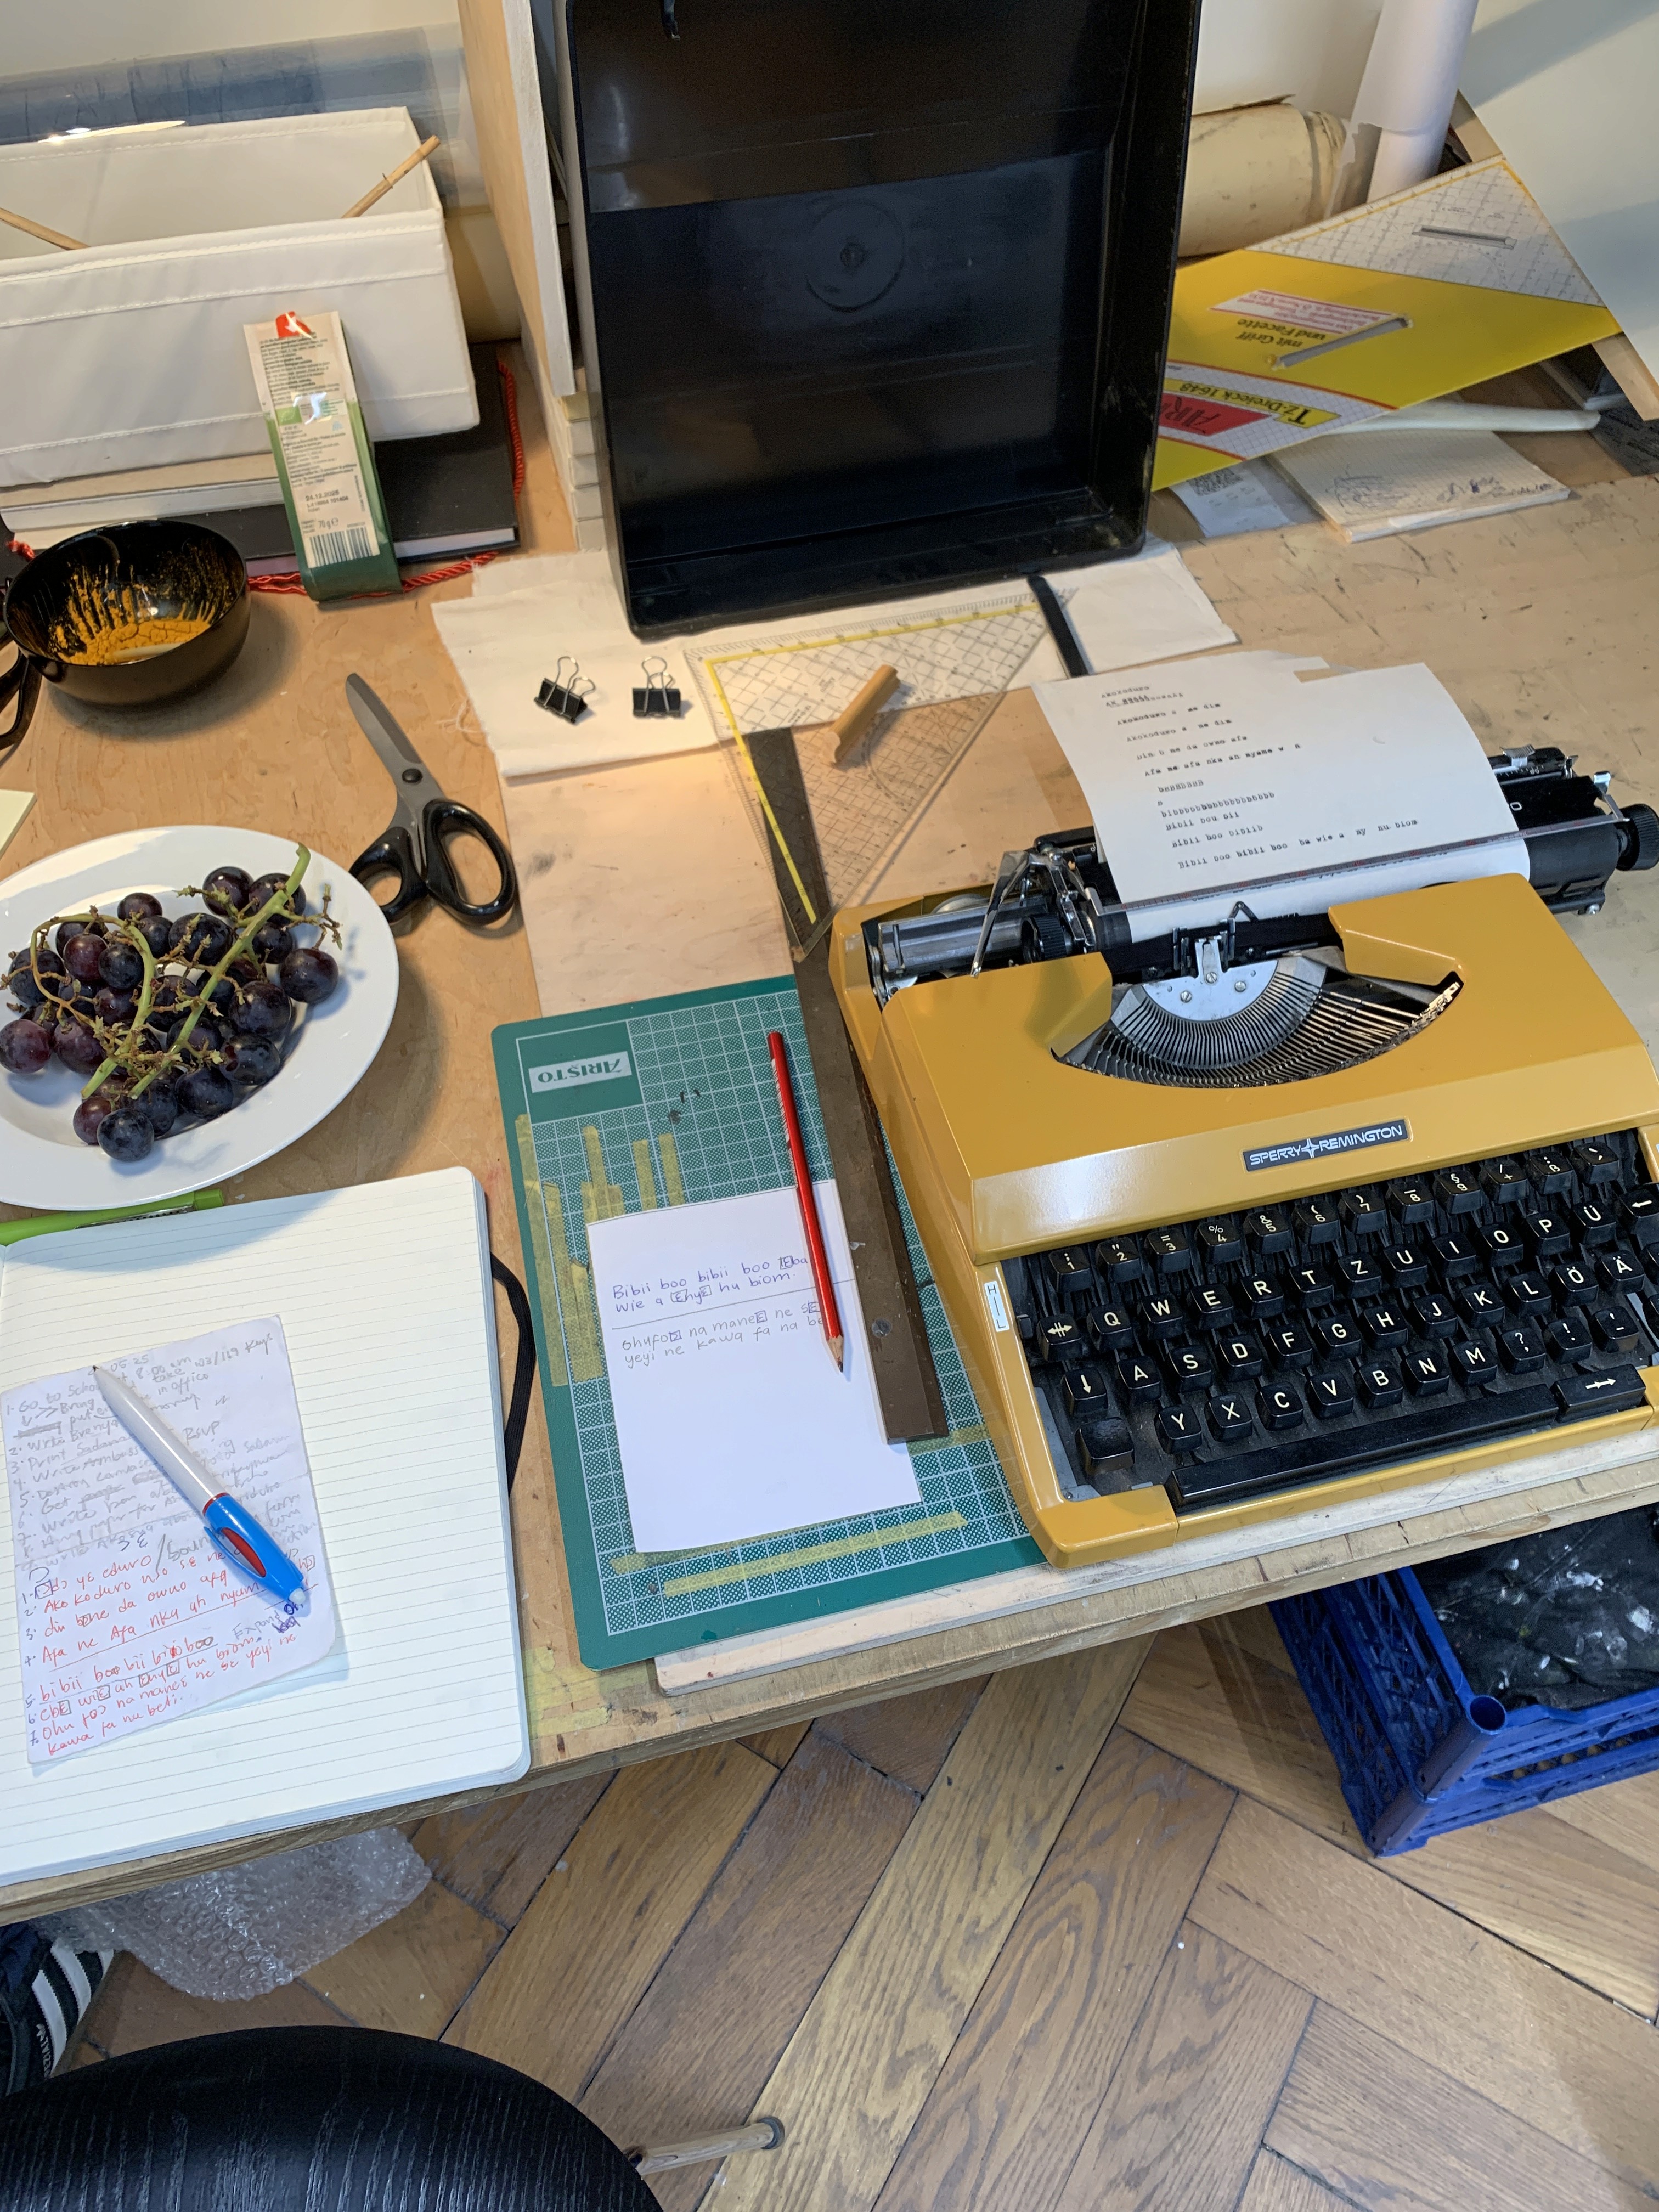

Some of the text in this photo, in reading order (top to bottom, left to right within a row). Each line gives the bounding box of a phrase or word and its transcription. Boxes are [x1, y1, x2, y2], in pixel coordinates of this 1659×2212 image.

[1235, 330, 1302, 348] mit Griff
[1237, 319, 1325, 341] und Facette
[1180, 382, 1219, 397] 1648
[318, 520, 325, 528] 70
[1178, 857, 1207, 869] Bibii
[1236, 847, 1265, 857] bibii
[1270, 843, 1288, 851] boo
[1316, 834, 1333, 843] wie
[1395, 819, 1418, 829] biom
[1205, 833, 1223, 841] boo
[538, 1058, 623, 1083] ARISTO
[1250, 1125, 1403, 1165] SPERRY REMINGTON
[1067, 1262, 1075, 1270] 1
[1116, 1252, 1128, 1261] 2
[1166, 1243, 1176, 1251] 3
[1217, 1234, 1227, 1242] 4
[1265, 1223, 1277, 1232] 5
[1314, 1214, 1326, 1222] 6
[1359, 1203, 1370, 1211] 7
[1409, 1193, 1421, 1202] 8
[1104, 1206, 1601, 1326] Q W E R T Z U I O P Ü
[613, 1262, 770, 1300] Bibii boo bibii boo
[656, 1297, 664, 1306] a
[719, 1282, 740, 1293] hu
[689, 1309, 793, 1338] na ne
[1135, 1256, 1633, 1381] A S D F G H J K L Ö Ä
[625, 1351, 655, 1369] yeyi
[664, 1345, 685, 1357] ne
[697, 1331, 743, 1350] kawa
[753, 1327, 771, 1342] fa
[780, 1322, 798, 1332] na
[1171, 1413, 1185, 1430] Y
[1221, 1402, 1240, 1420] X
[1274, 1392, 1290, 1408] C
[1322, 1379, 1337, 1396] V
[1372, 1370, 1389, 1386] B
[1418, 1358, 1437, 1375] N
[1465, 1347, 1486, 1364] M
[19, 1400, 38, 1413] Go
[46, 1393, 61, 1404] to
[60, 1398, 95, 1414] Bring
[27, 1450, 66, 1471] Print
[41, 1498, 71, 1515] Get
[119, 1598, 137, 1613] da
